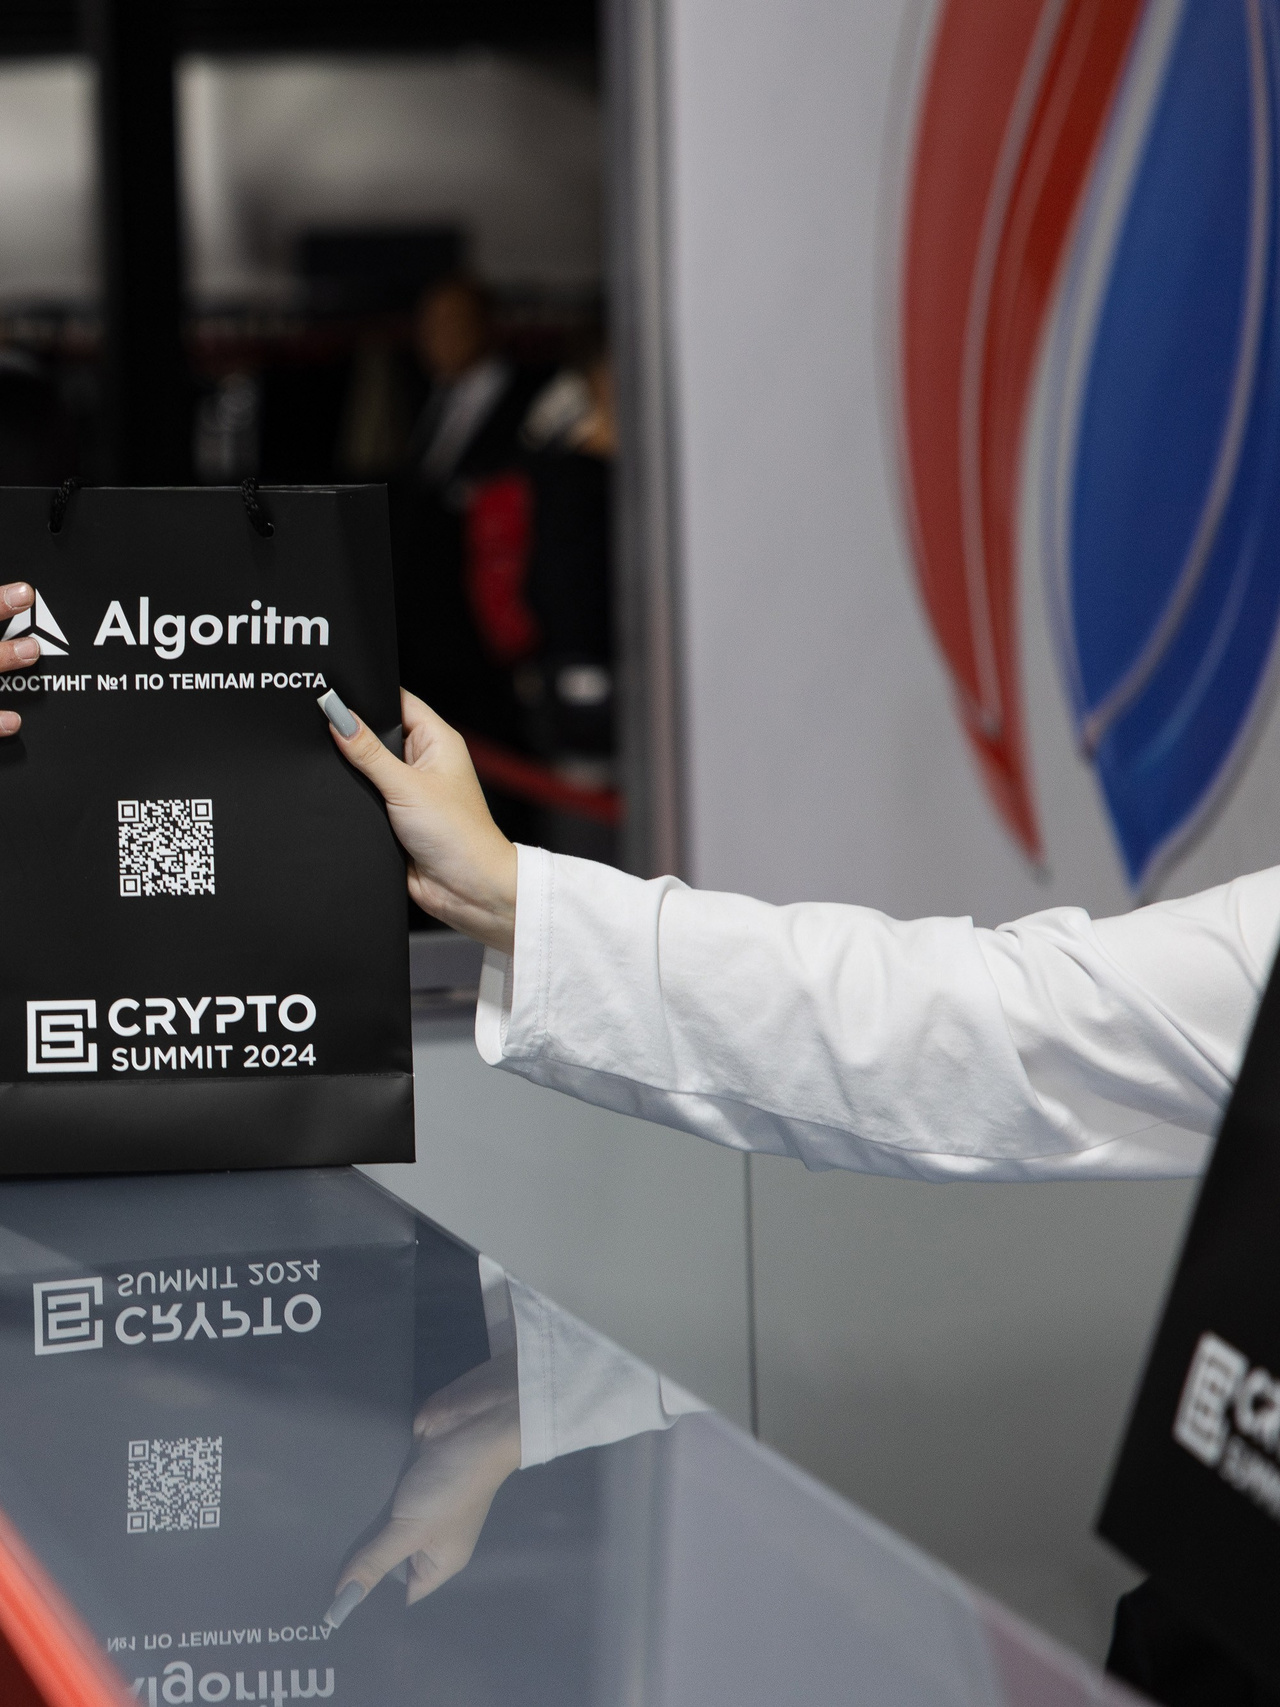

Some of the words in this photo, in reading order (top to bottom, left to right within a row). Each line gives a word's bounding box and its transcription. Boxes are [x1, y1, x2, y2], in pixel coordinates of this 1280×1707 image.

[93, 596, 329, 659] Algoritm
[0, 674, 92, 692] ХОСТИНГ
[97, 674, 127, 691] №1
[135, 673, 164, 691] ПО
[169, 672, 254, 690] ТЕМПАМ
[261, 672, 327, 689] РОСТА
[108, 994, 317, 1037] CRYPTO
[111, 1044, 233, 1071] SUMMIT
[243, 1043, 317, 1068] 2024
